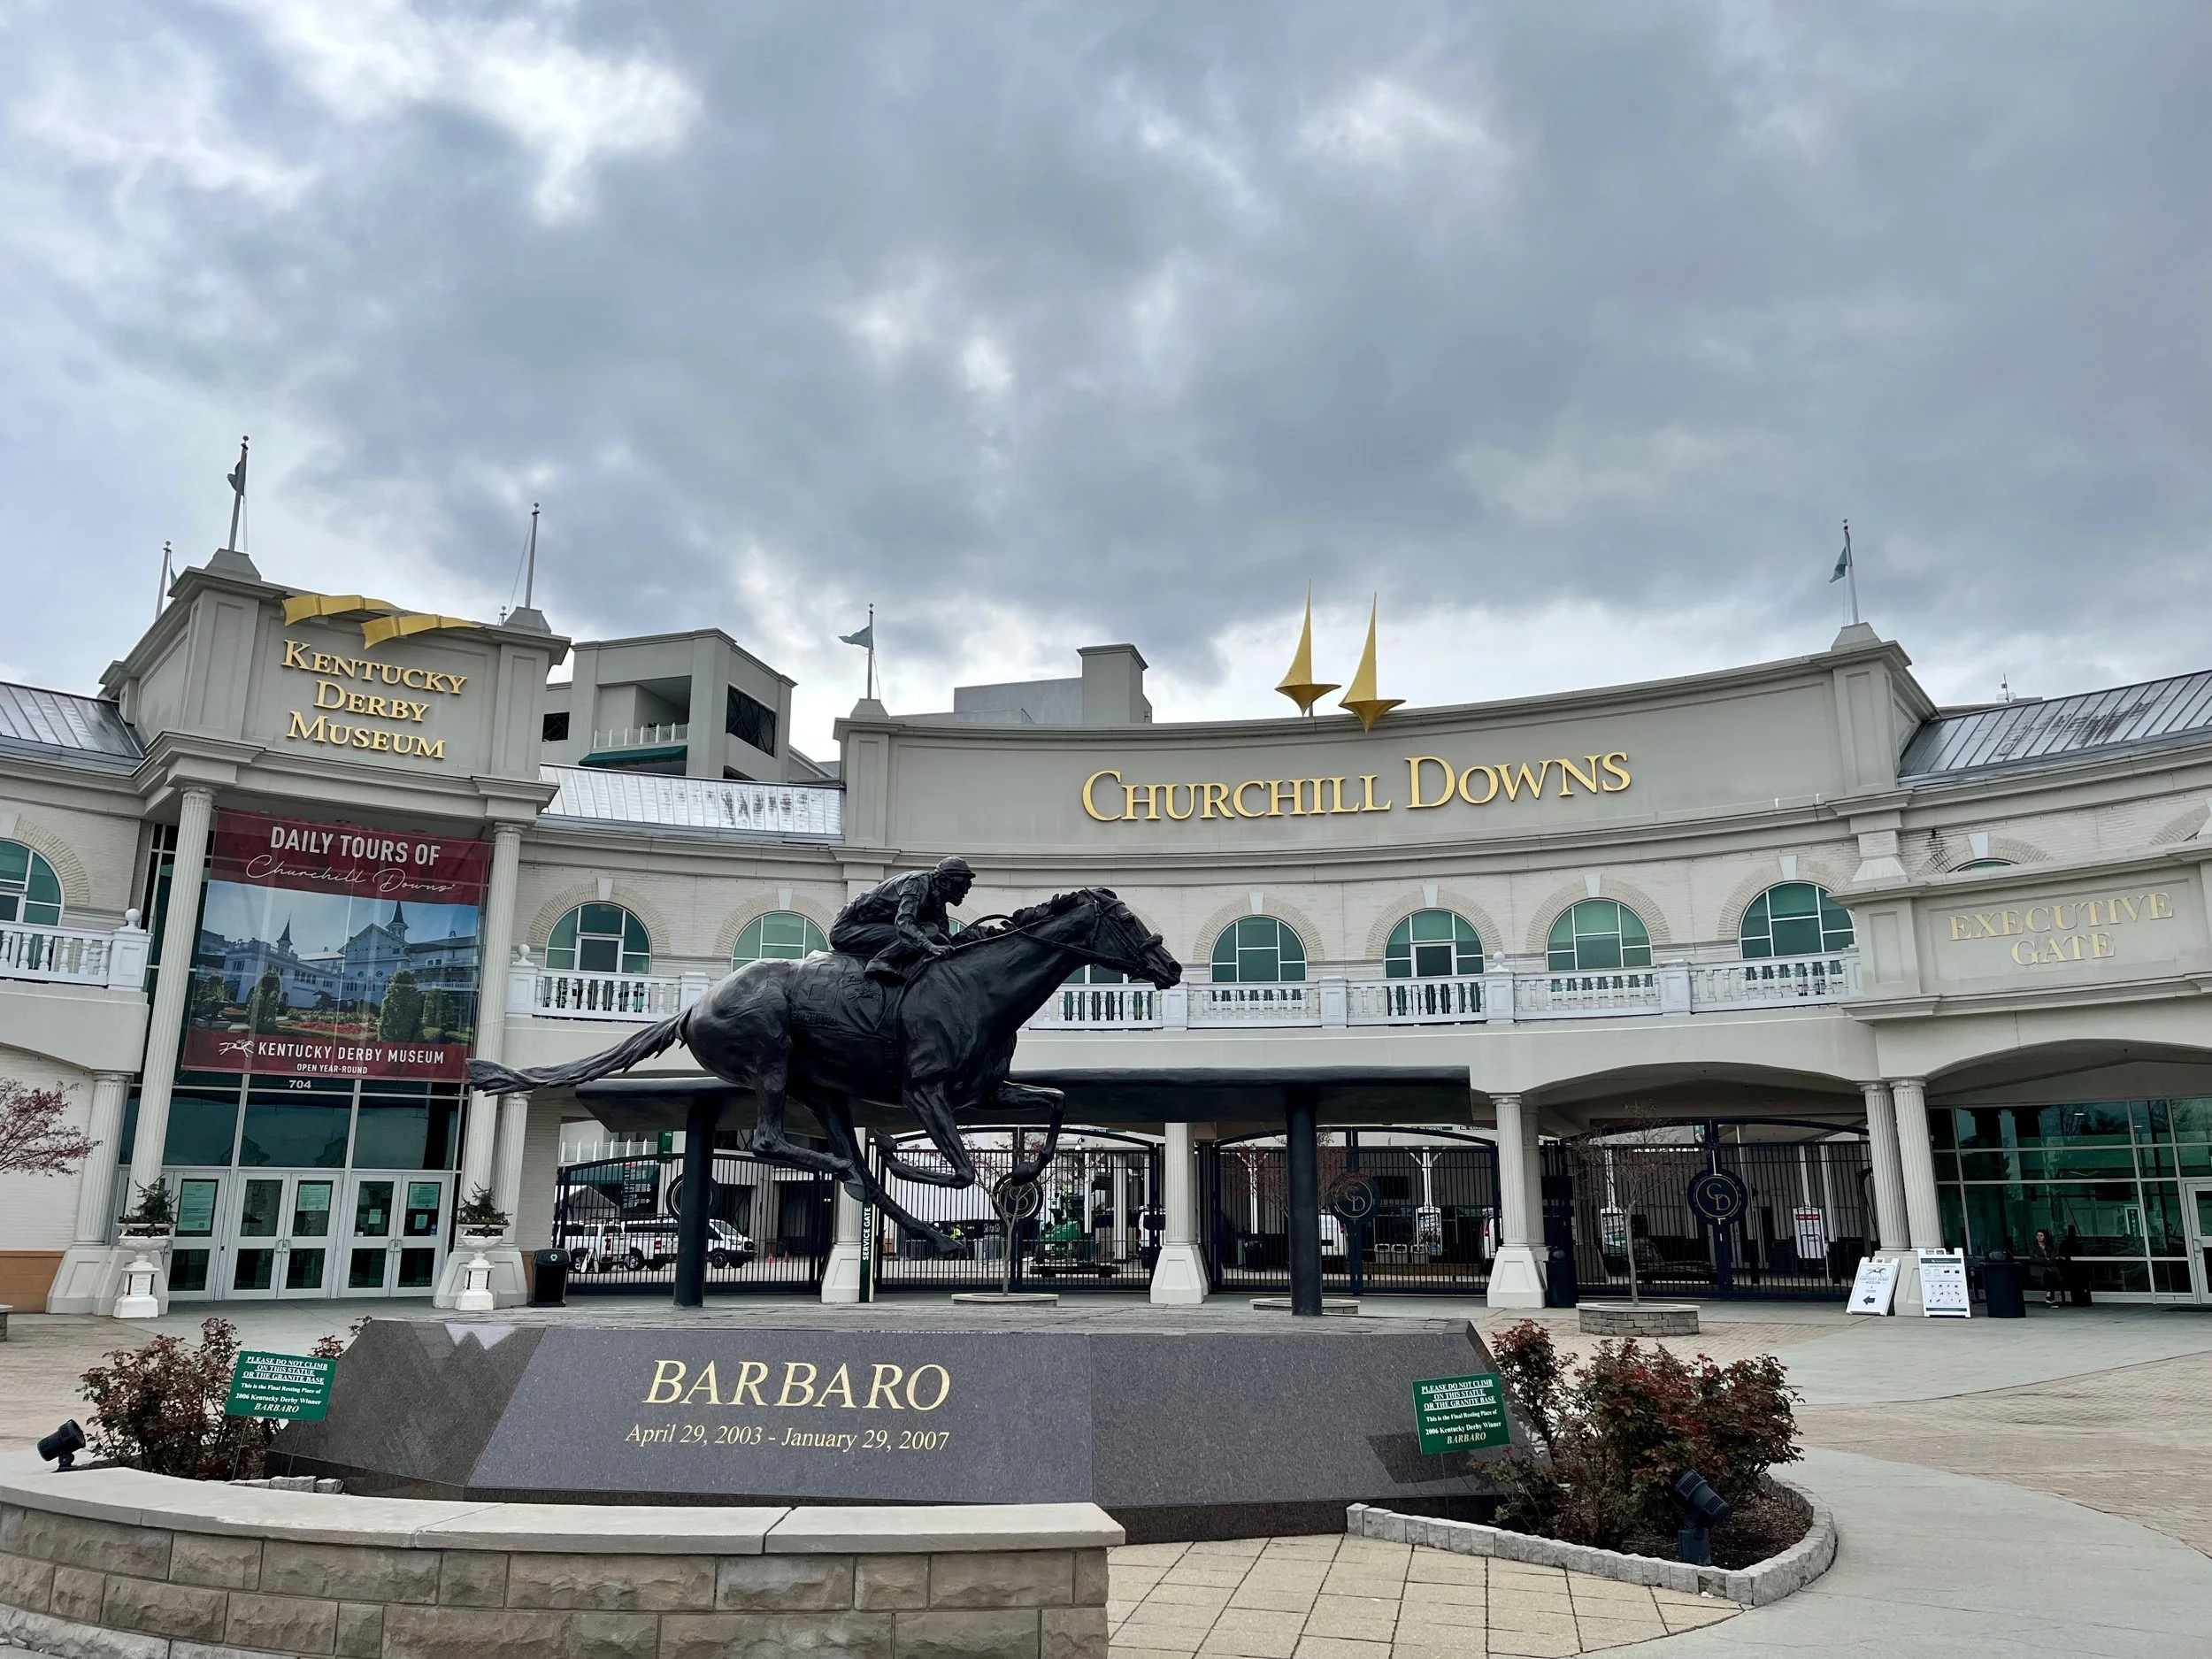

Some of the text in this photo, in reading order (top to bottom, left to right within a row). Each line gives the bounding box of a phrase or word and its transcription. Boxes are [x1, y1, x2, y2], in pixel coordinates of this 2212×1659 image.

[281, 639, 467, 695] KENTUCKY
[313, 680, 430, 722] DERBY
[287, 710, 446, 759] MUSEUM
[1081, 751, 1632, 822] CHURCHILL DOWNS
[270, 826, 442, 866] DAILY TOURS OF
[246, 854, 366, 883] Churchill
[1948, 892, 2174, 941] EXECUTIVE
[2011, 932, 2116, 966] GATE
[257, 1042, 444, 1064] KENTUCKY DERBY MUSEUM
[296, 1063, 368, 1074] OPEN YEAR-ROUND
[288, 1079, 311, 1089] 704
[862, 1228, 871, 1261] SERVICE
[272, 1373, 305, 1382] GRANITE
[641, 1359, 951, 1411] BARBARO
[1421, 1384, 1448, 1393] PLEASE
[250, 1394, 279, 1403] Kentucky
[1450, 1398, 1479, 1407] GRANITE
[1461, 1388, 1485, 1397] STATUE
[254, 1403, 300, 1413] BARBARO
[625, 1423, 676, 1448] April
[680, 1425, 708, 1447] 29,
[715, 1425, 762, 1445] 2003
[781, 1427, 856, 1453] January
[862, 1429, 893, 1452] 29,
[899, 1431, 950, 1450] 2007
[1447, 1432, 1486, 1444] BARBARO
[1466, 1423, 1482, 1432] Derby
